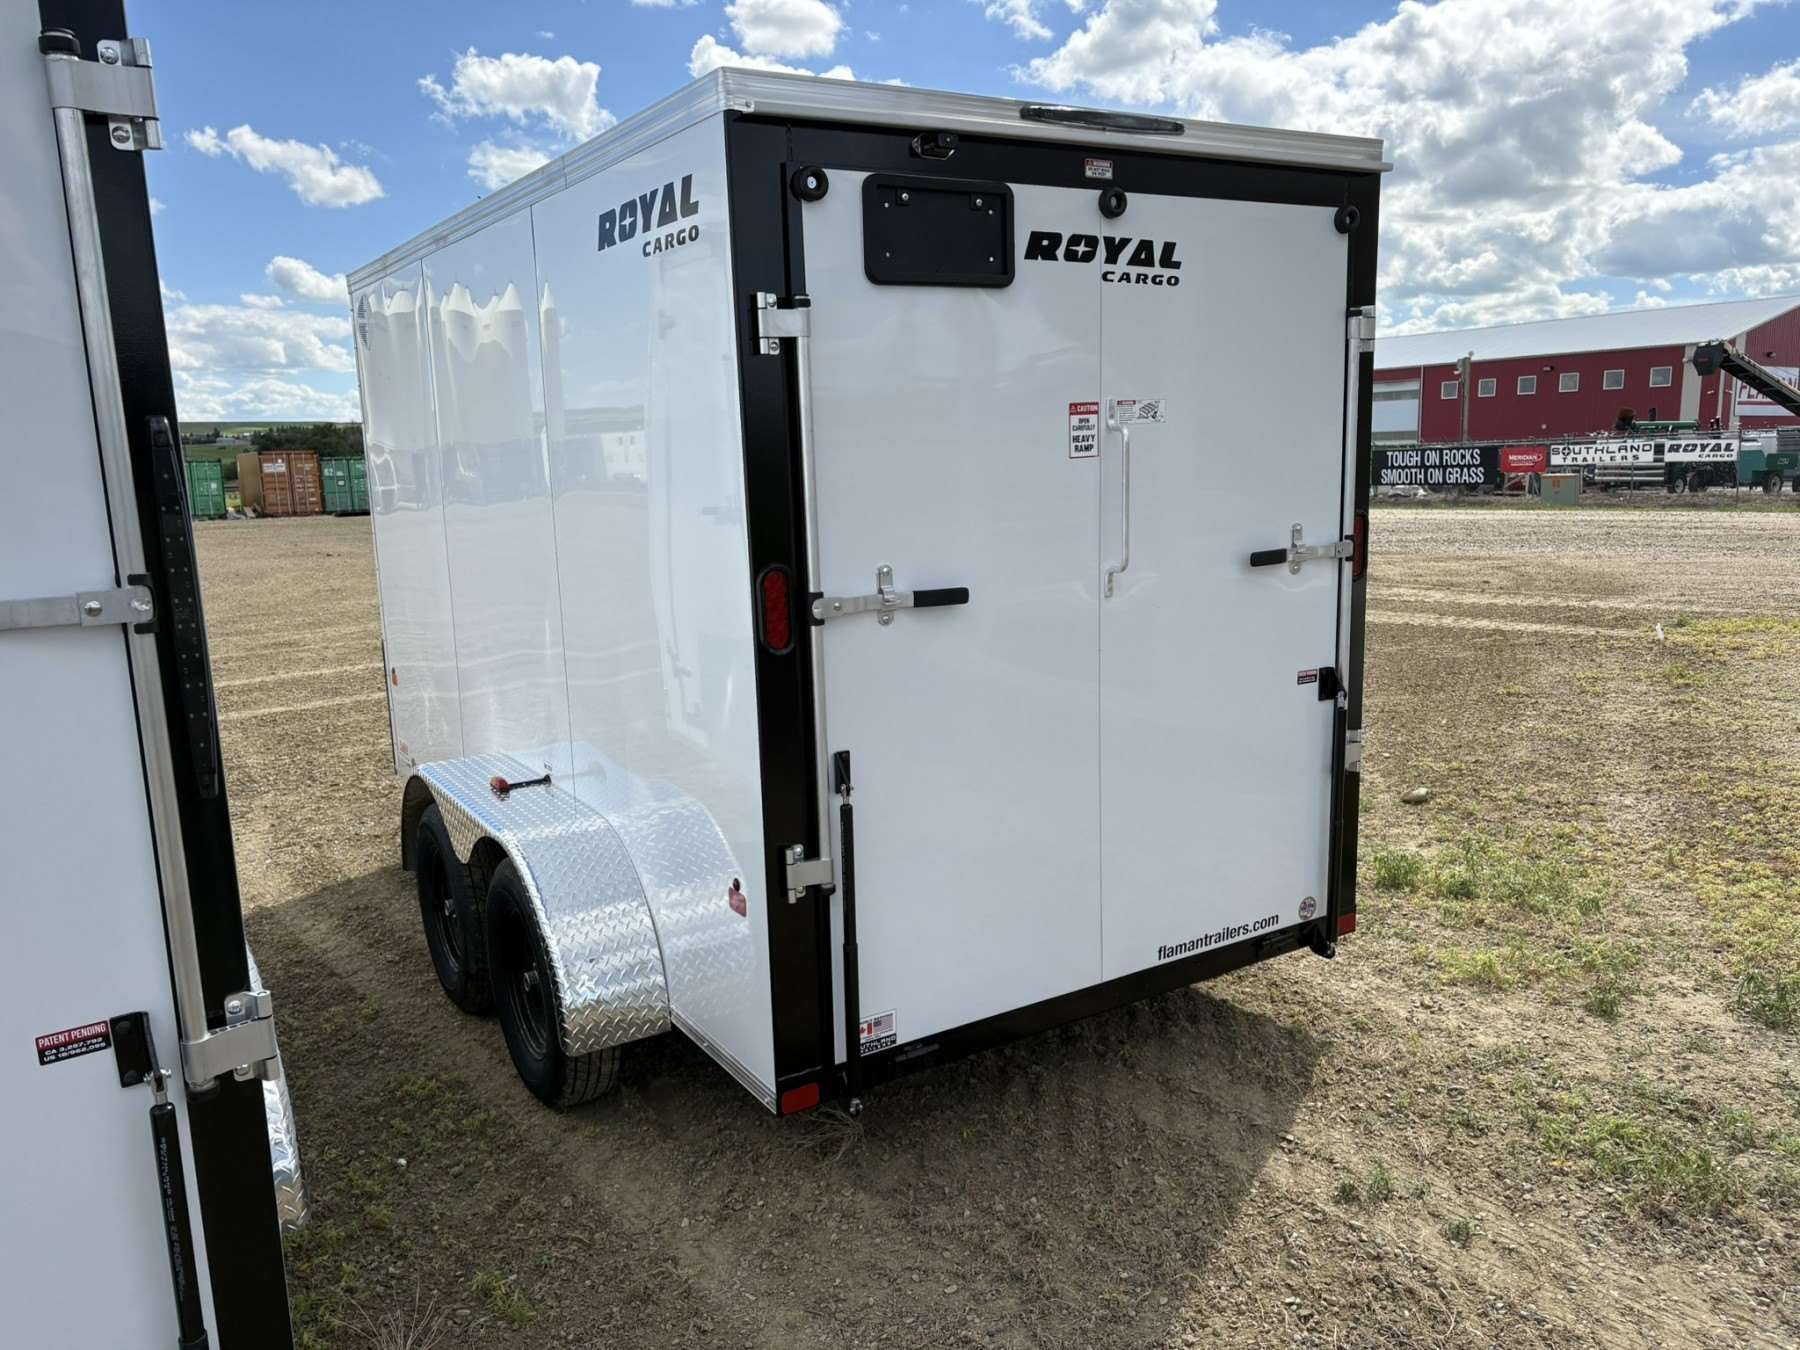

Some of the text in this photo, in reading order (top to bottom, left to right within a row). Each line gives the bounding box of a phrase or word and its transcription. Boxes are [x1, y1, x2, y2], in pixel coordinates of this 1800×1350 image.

[597, 173, 699, 251] ROYAL
[642, 225, 699, 257] CARGO
[1024, 231, 1182, 270] ROYAL
[1101, 271, 1180, 286] CARGO
[1072, 434, 1096, 443] HEAVY
[1074, 444, 1094, 452] RAMP
[1551, 443, 1653, 457] SOUTHLAND
[1667, 442, 1735, 453] ROYAL
[1386, 448, 1481, 467] TOUGH ON ROCKS
[1561, 454, 1640, 463] TRAILERS
[1381, 467, 1485, 484] SMOOTH ON GRASS
[1157, 914, 1280, 961] flamantrailers.com
[38, 1023, 106, 1048] PATENT PENDING
[45, 1048, 57, 1056] CA
